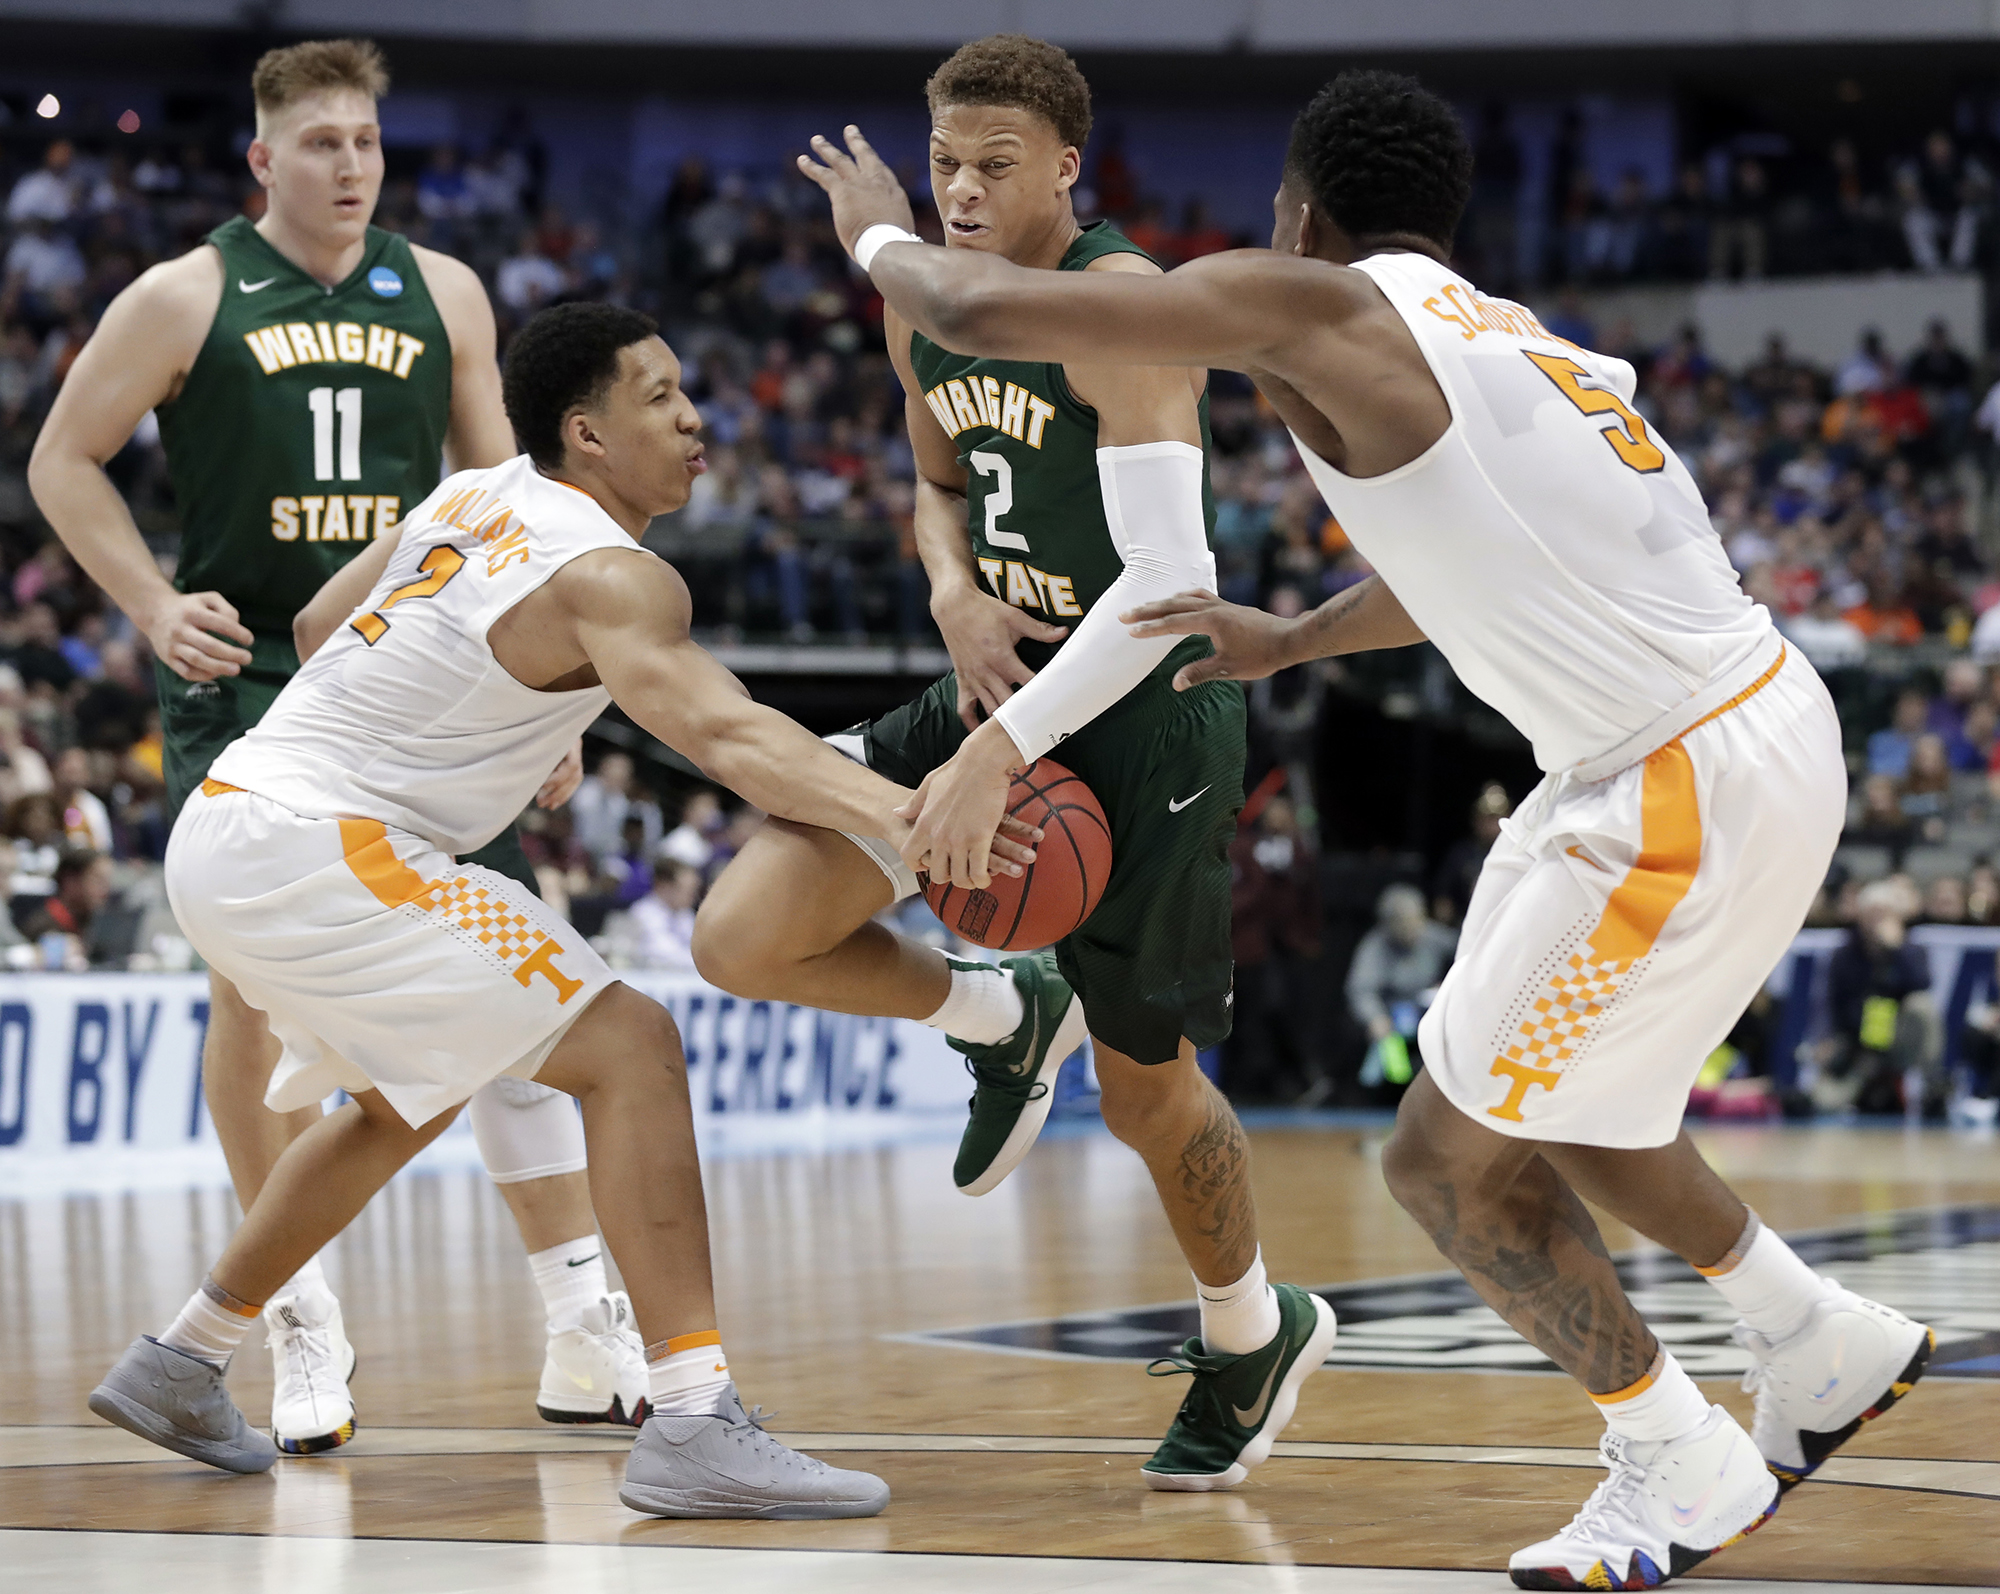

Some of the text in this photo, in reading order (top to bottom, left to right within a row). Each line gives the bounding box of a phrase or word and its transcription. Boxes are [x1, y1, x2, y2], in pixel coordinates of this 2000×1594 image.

[243, 321, 425, 380] WRIGHT
[308, 387, 362, 481] 11
[924, 375, 1056, 450] WRIGHT
[1519, 349, 1665, 474] 5
[271, 495, 400, 541] STATE
[430, 488, 530, 578] WILLIAMS
[969, 450, 1031, 553] 2
[349, 543, 469, 648] 2
[976, 556, 1084, 617] TATE
[511, 937, 585, 1006] T
[67, 1001, 161, 1144] BY
[664, 996, 901, 1112] FERENCE
[1486, 1054, 1563, 1124] T
